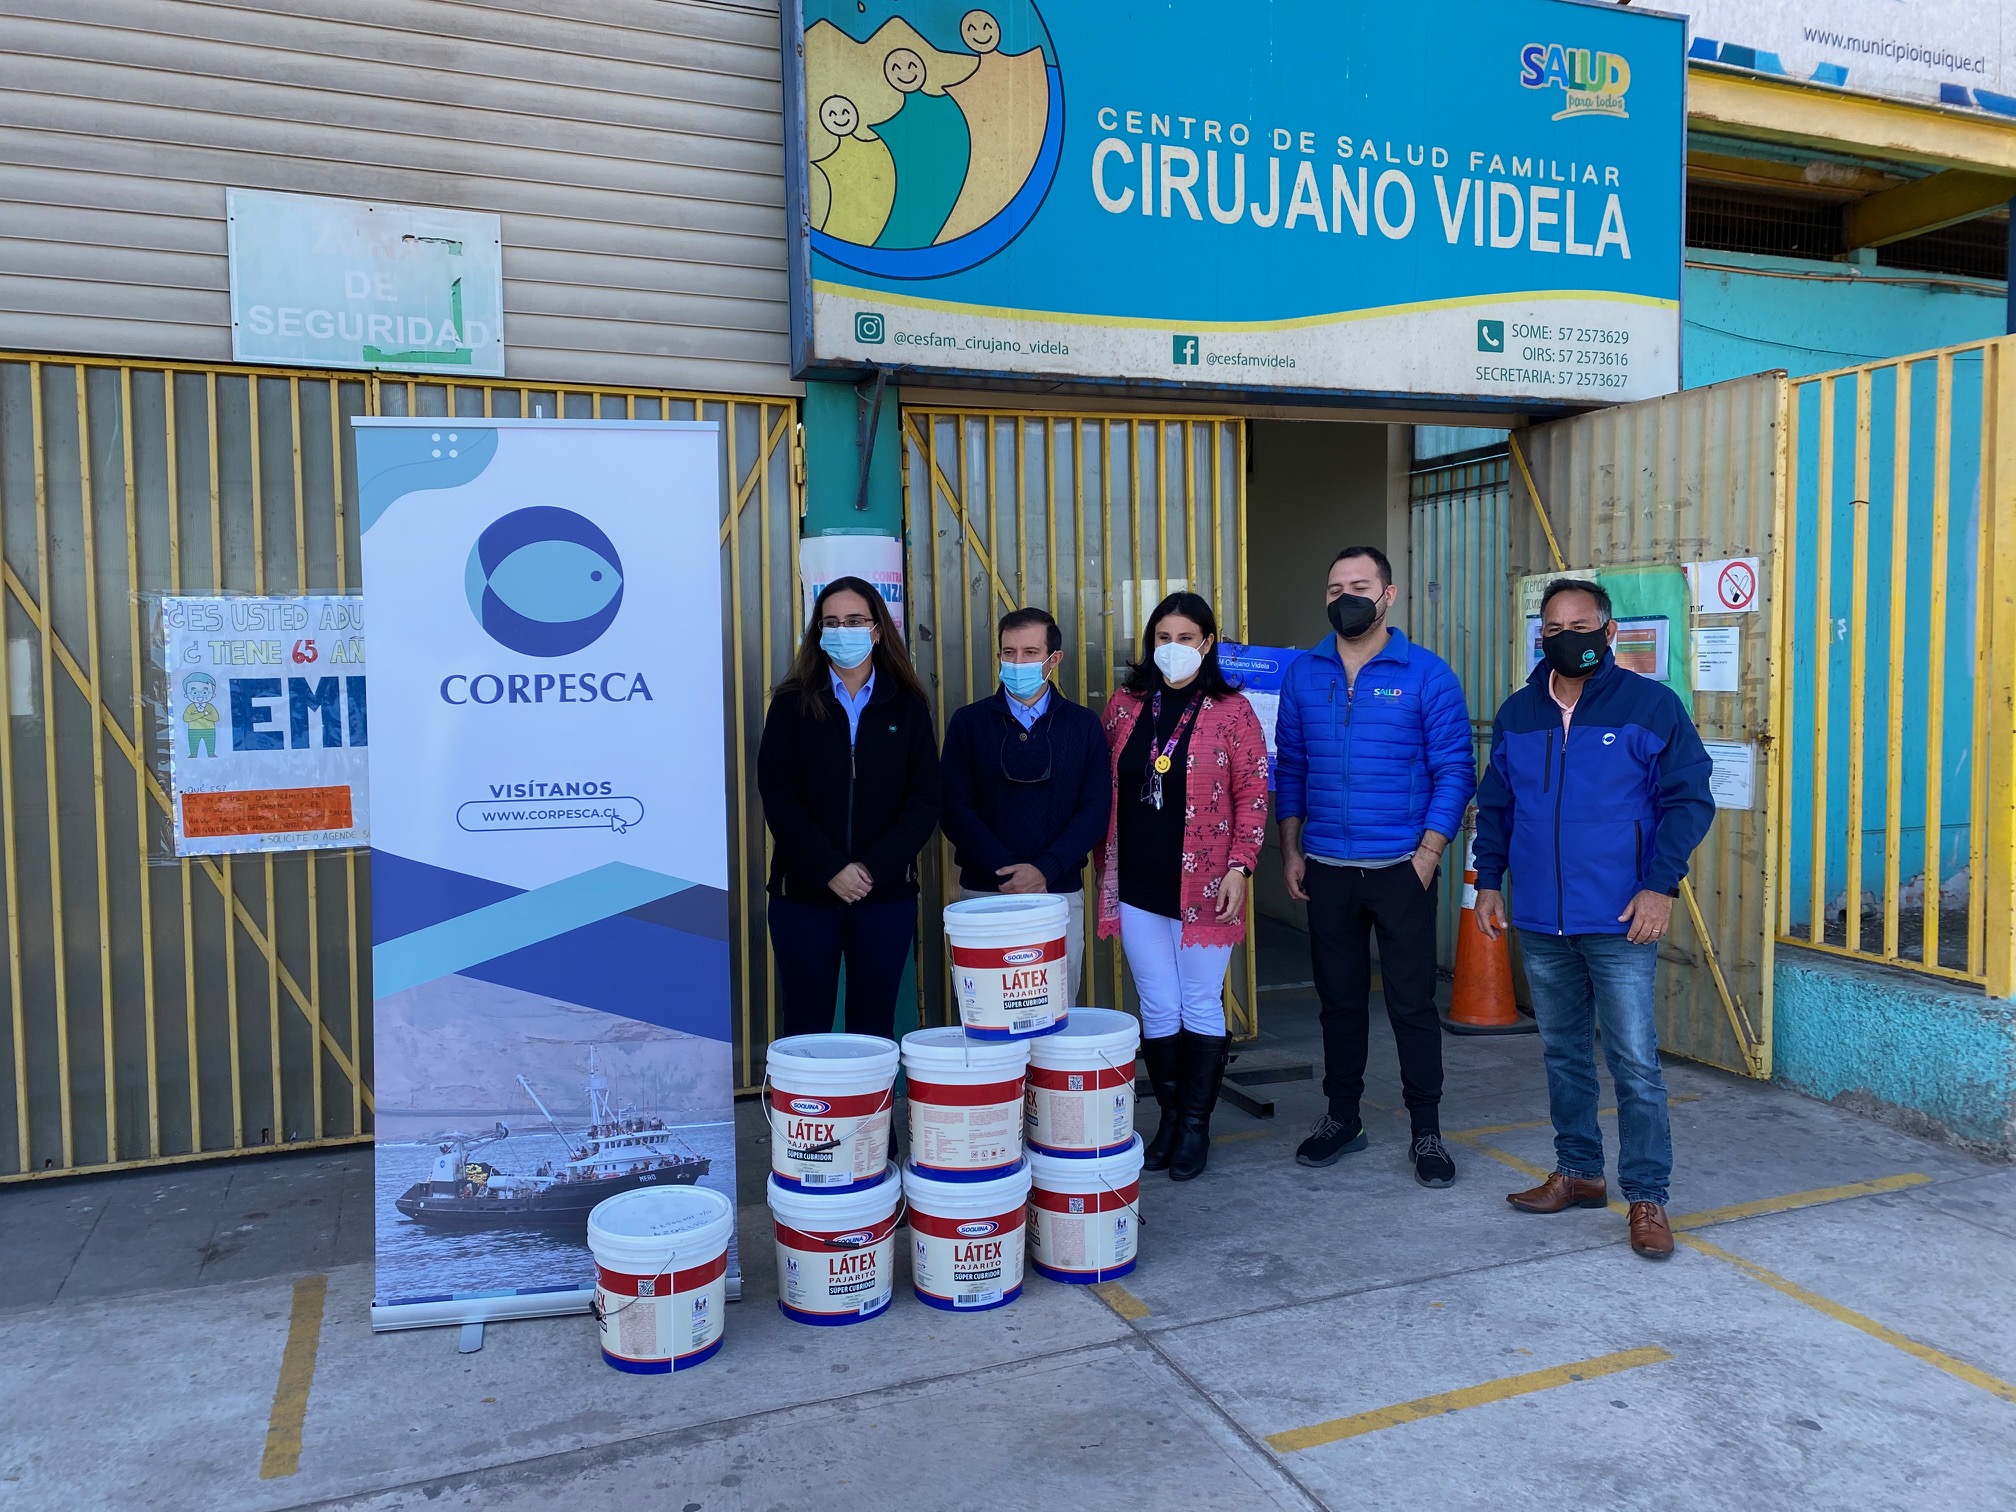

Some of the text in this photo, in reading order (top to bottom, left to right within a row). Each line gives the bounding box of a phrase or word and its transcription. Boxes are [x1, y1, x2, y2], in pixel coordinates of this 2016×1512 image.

[1804, 27, 1985, 73] www.municipioiquique.cl
[1522, 45, 1630, 94] SALUD
[1568, 94, 1623, 108] para todos
[1097, 107, 1620, 187] CENTRO DE SALUD FAMILIAR
[1091, 137, 1632, 260] CIRUJANO VIDELA
[345, 269, 398, 302] DE
[249, 305, 489, 349] SEGURIDAD
[1512, 323, 1629, 344] SOME: 57 2573629
[894, 331, 1069, 356] @cesfam_cirujano_videla
[1206, 351, 1296, 369] @cesfamvidela
[1522, 346, 1628, 366] OIRS: 57 2573616
[1475, 366, 1628, 387] SECRETARIA: 57 2573627
[230, 603, 309, 631] USTED
[291, 639, 319, 664] 65
[1225, 658, 1250, 668] Cirujano
[1251, 660, 1270, 670] Videla
[440, 672, 654, 705] CORPESCA
[1373, 688, 1402, 697] SALUD
[489, 780, 612, 799] VISÍTANOS
[481, 807, 619, 822] WWW.CORPESCA.CL
[268, 833, 308, 843] SOLICITE
[323, 831, 356, 840] AGENDE
[1002, 969, 1048, 990] LÁTEX
[1003, 988, 1048, 998] PAJARITO
[1004, 996, 1048, 1009] SÚPER CUBRIDOR
[787, 1119, 835, 1142] LÁTEX
[787, 1150, 832, 1161] SÚPER CUBRIDOR
[638, 1173, 656, 1182] MERO
[954, 1240, 1002, 1262] LÁTEX
[829, 1250, 876, 1275] LÁTEX
[954, 1260, 1001, 1270] PAJARITO
[829, 1270, 876, 1283] PAJARITO
[955, 1270, 1000, 1280] SÚPER CUBRIDOR
[829, 1280, 875, 1294] SÚPER CUBRIDOR
